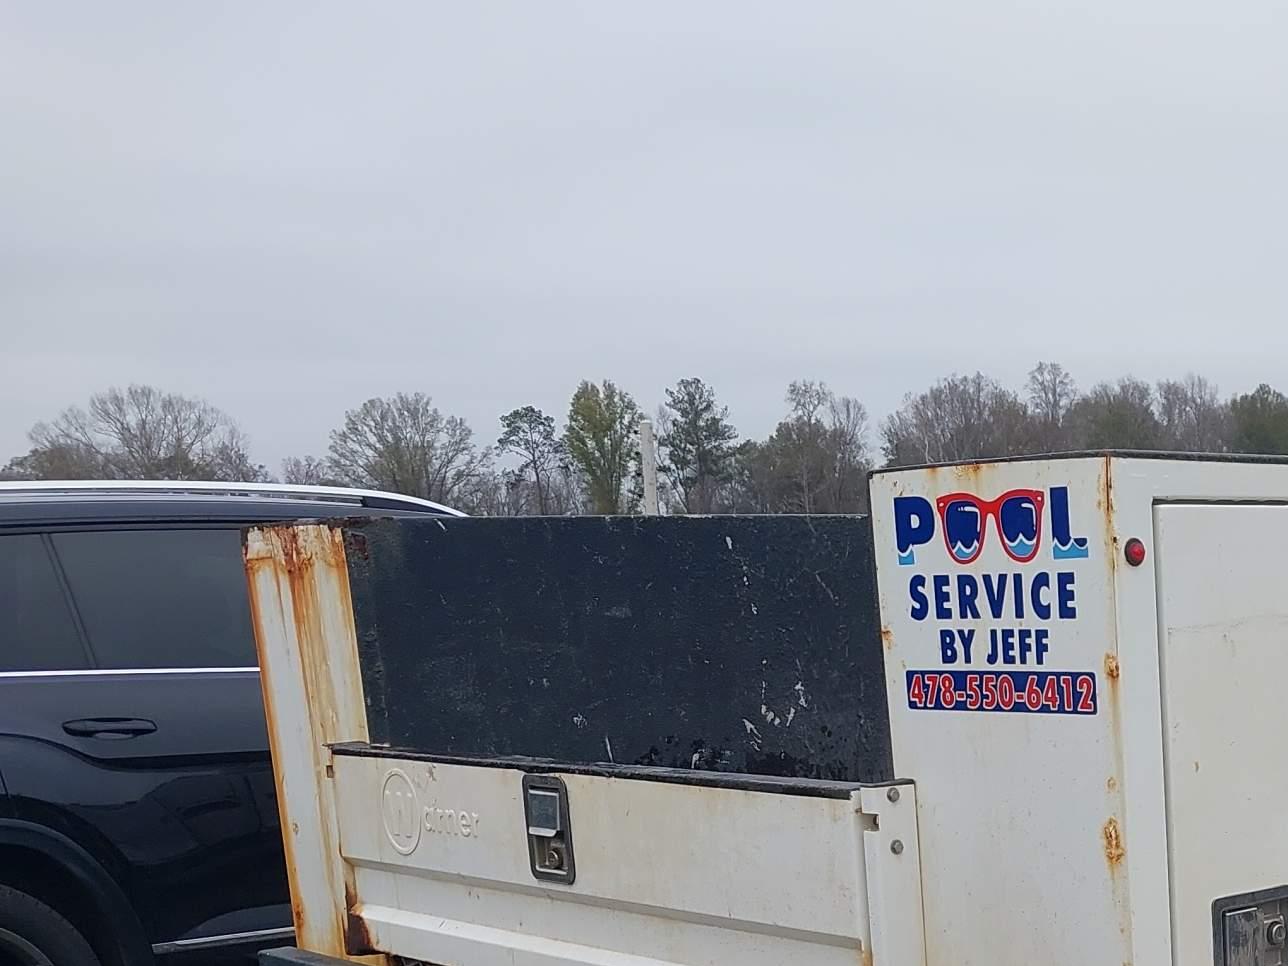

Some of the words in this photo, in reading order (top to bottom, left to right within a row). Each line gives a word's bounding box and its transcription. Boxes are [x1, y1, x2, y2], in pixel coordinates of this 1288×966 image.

[893, 486, 1089, 566] POOL
[908, 571, 1078, 622] SERVICE
[939, 628, 976, 665] BY
[986, 628, 1049, 666] JEFF
[908, 672, 1095, 713] 478-550-6412
